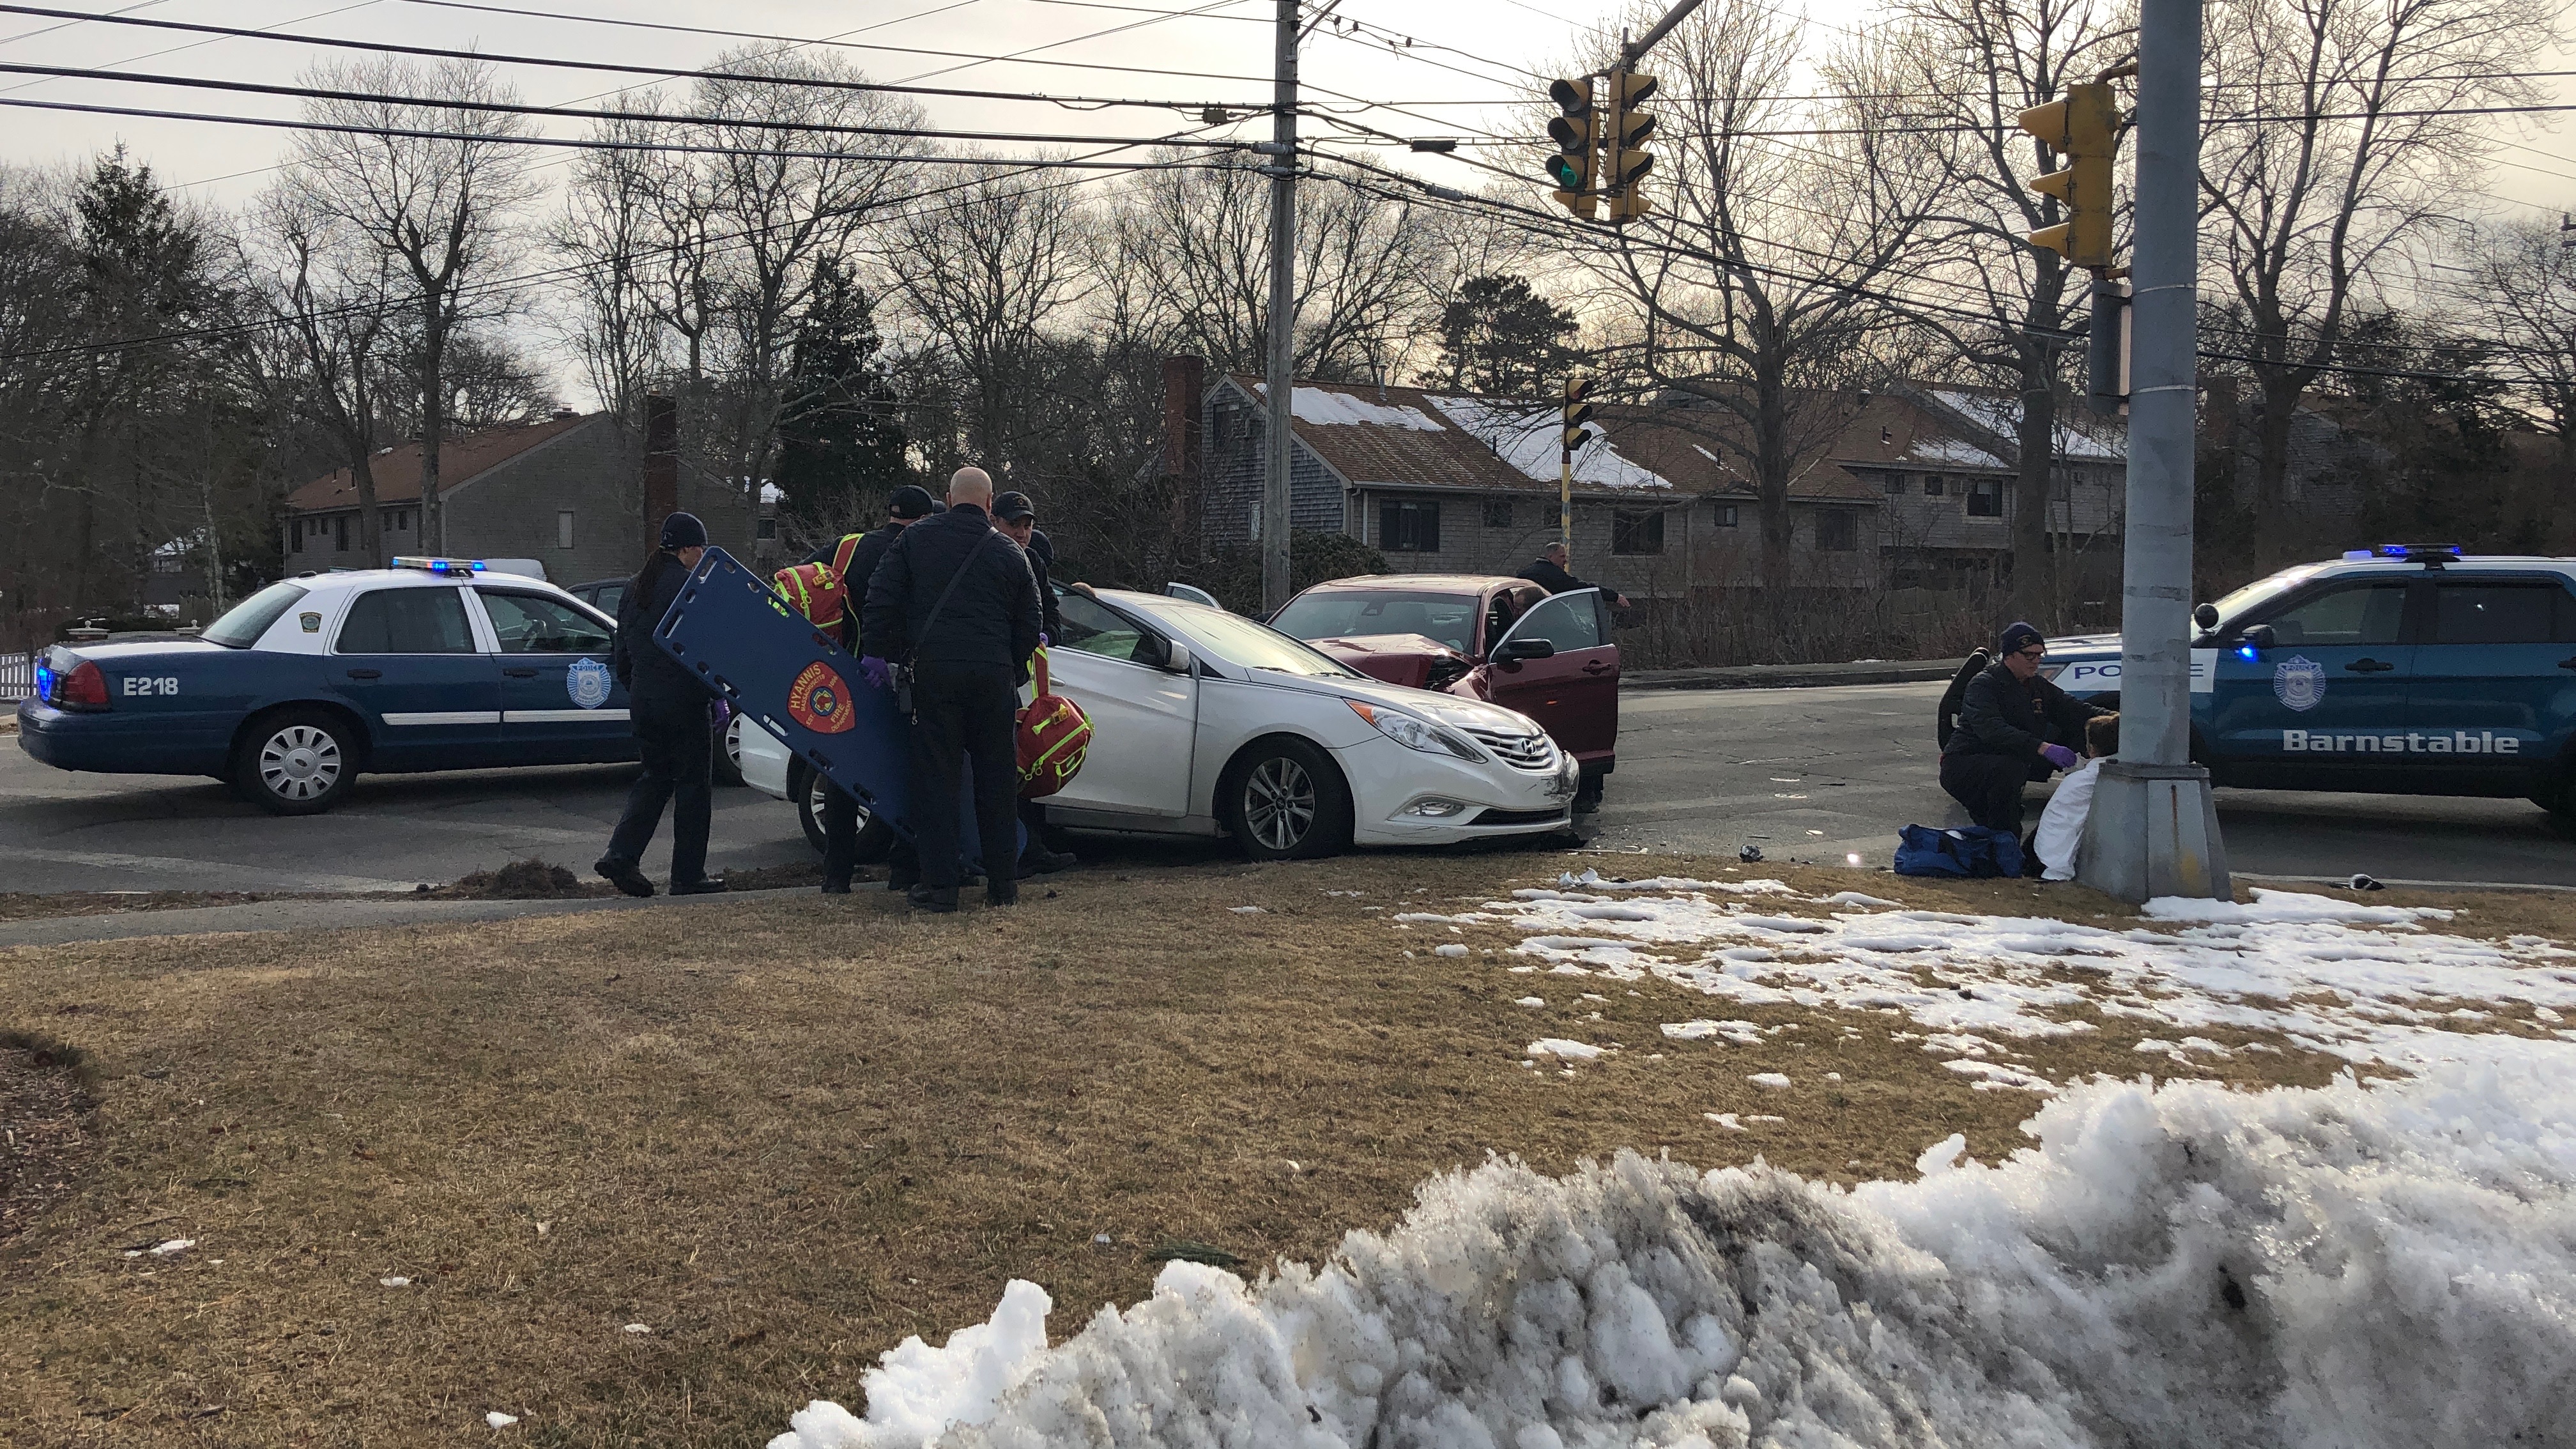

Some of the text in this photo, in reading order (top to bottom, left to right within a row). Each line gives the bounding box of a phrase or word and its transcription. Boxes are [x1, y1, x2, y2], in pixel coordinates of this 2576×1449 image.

[2074, 664, 2204, 679] POE
[124, 677, 178, 696] E218
[791, 664, 821, 709] HYANNIS
[801, 674, 825, 712] MASSACHUSETTS
[831, 703, 845, 723] FIRE
[831, 699, 852, 732] DEPARTMENT
[2283, 730, 2519, 754] Barnstable
